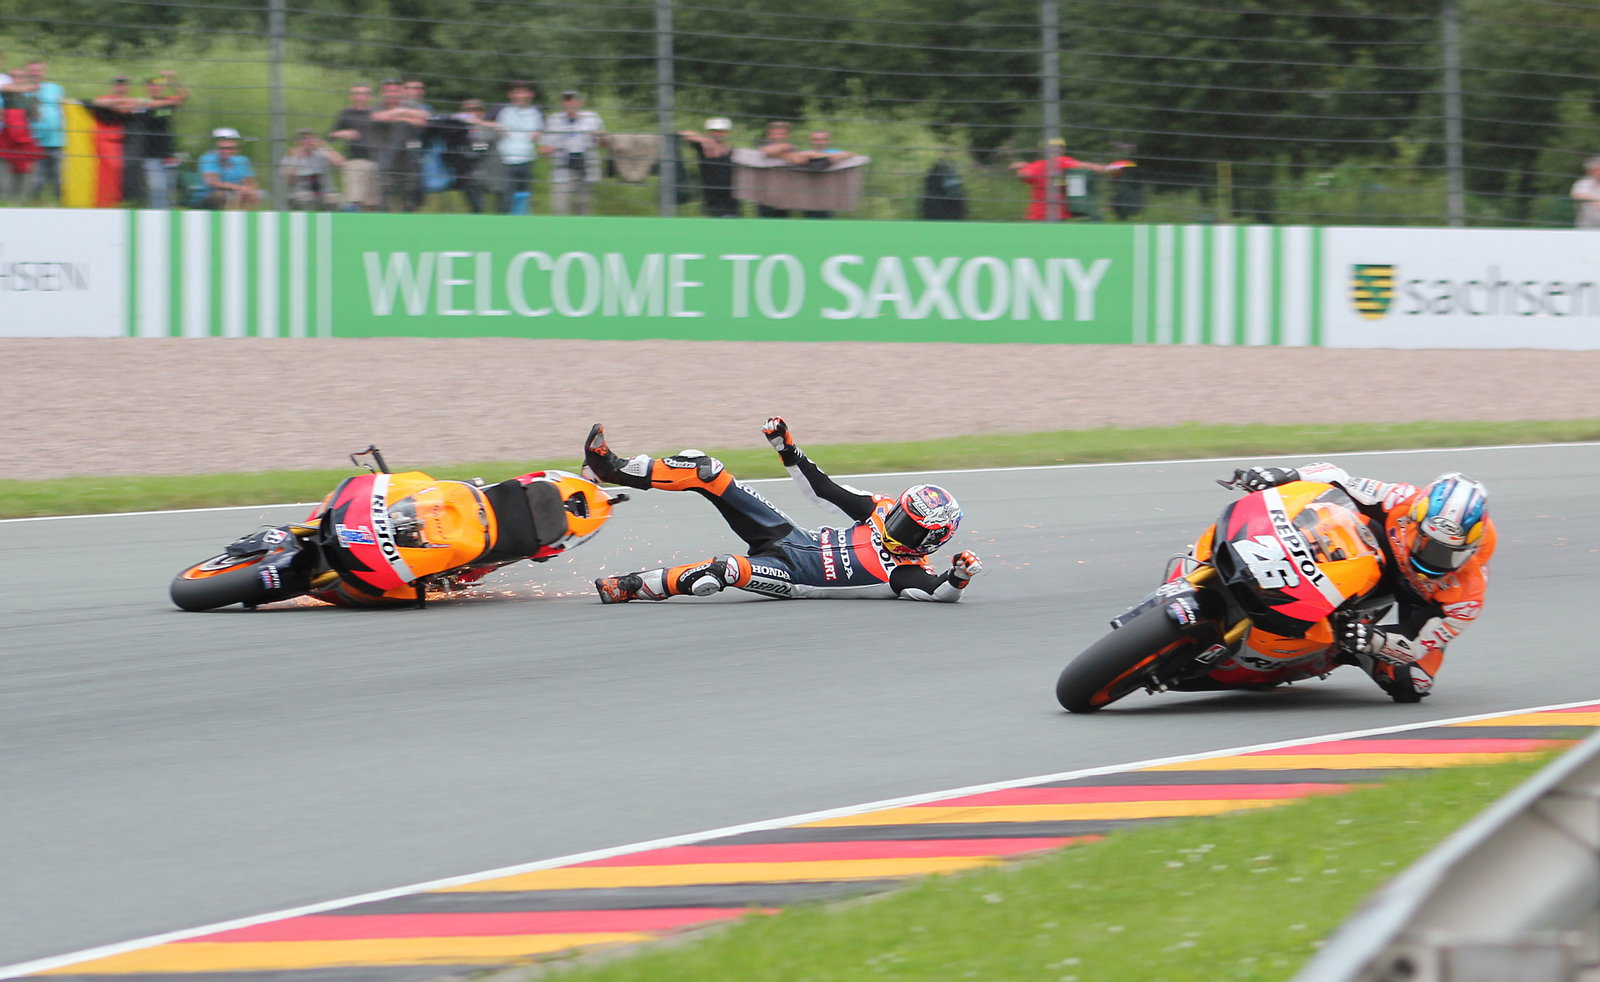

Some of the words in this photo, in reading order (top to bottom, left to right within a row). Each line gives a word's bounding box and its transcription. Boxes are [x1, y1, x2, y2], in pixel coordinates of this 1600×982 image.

[362, 250, 706, 317] WELCOME
[721, 253, 806, 320] TO
[819, 253, 1113, 322] SAXONY
[1403, 264, 1600, 318] sachsen
[374, 494, 401, 565] REPSOL
[838, 529, 854, 580] HONDA
[1271, 509, 1325, 588] REPSOL
[746, 579, 792, 596] REPSOL
[752, 564, 791, 581] HONDA
[1232, 535, 1301, 589] 26
